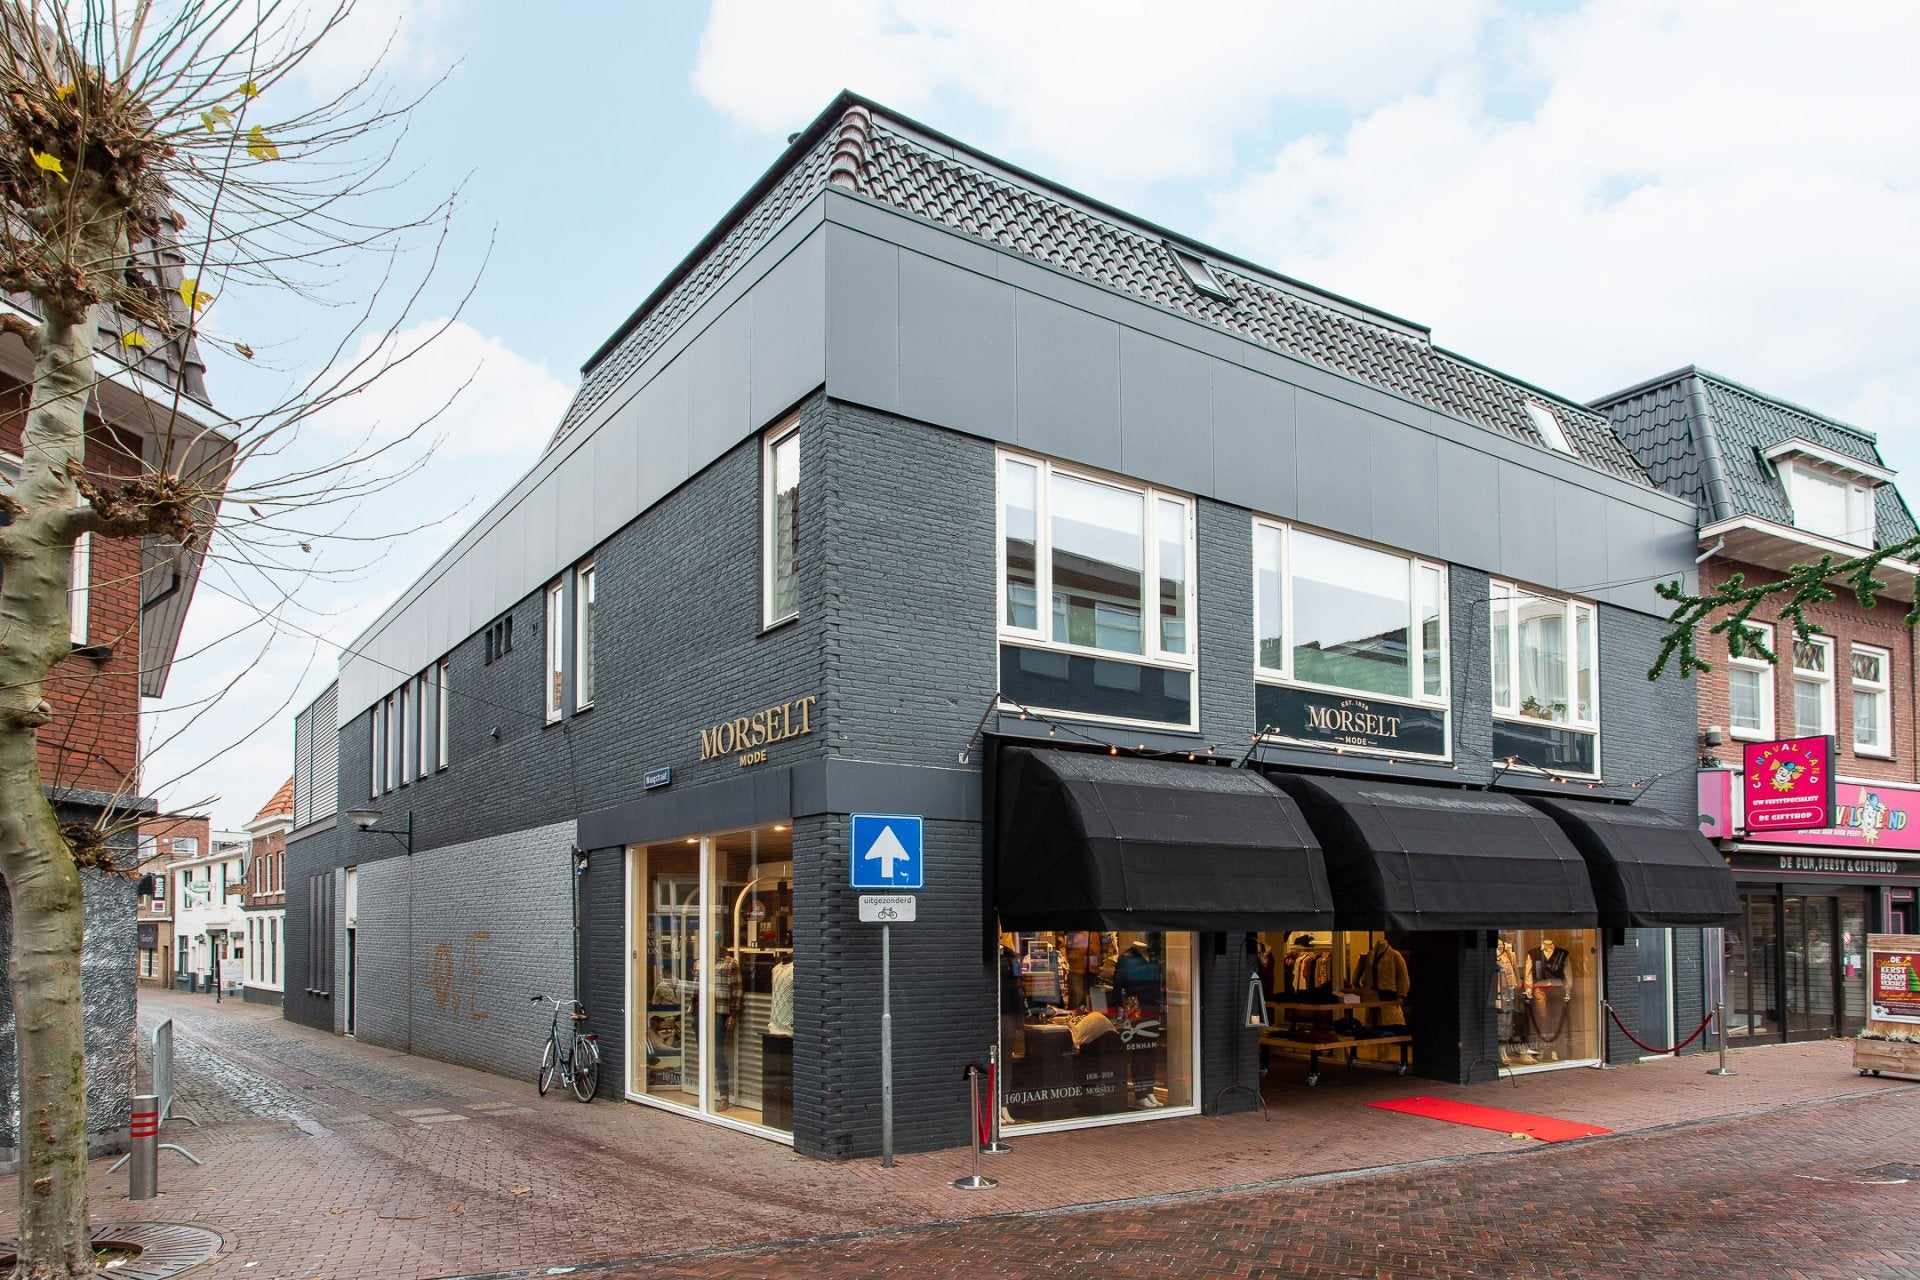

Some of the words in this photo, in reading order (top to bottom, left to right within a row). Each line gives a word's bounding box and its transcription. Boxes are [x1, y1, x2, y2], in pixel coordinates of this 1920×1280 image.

[1308, 706, 1400, 738] MORSELT
[700, 695, 817, 760] MORSELT
[1345, 736, 1367, 746] MODE
[739, 750, 768, 767] MODE
[1771, 812, 1813, 821] GIFTSHOP
[1780, 856, 1792, 868] DE
[1847, 861, 1854, 872] &
[1854, 860, 1897, 873] GIFTSHOP
[864, 897, 912, 906] uitgezonderd
[1890, 956, 1902, 964] DE
[1880, 966, 1907, 974] KERST
[1126, 1042, 1158, 1050] DENHAM
[1004, 1092, 1020, 1104] 160
[1022, 1088, 1048, 1104] JAAR
[1050, 1086, 1082, 1099] MODE
